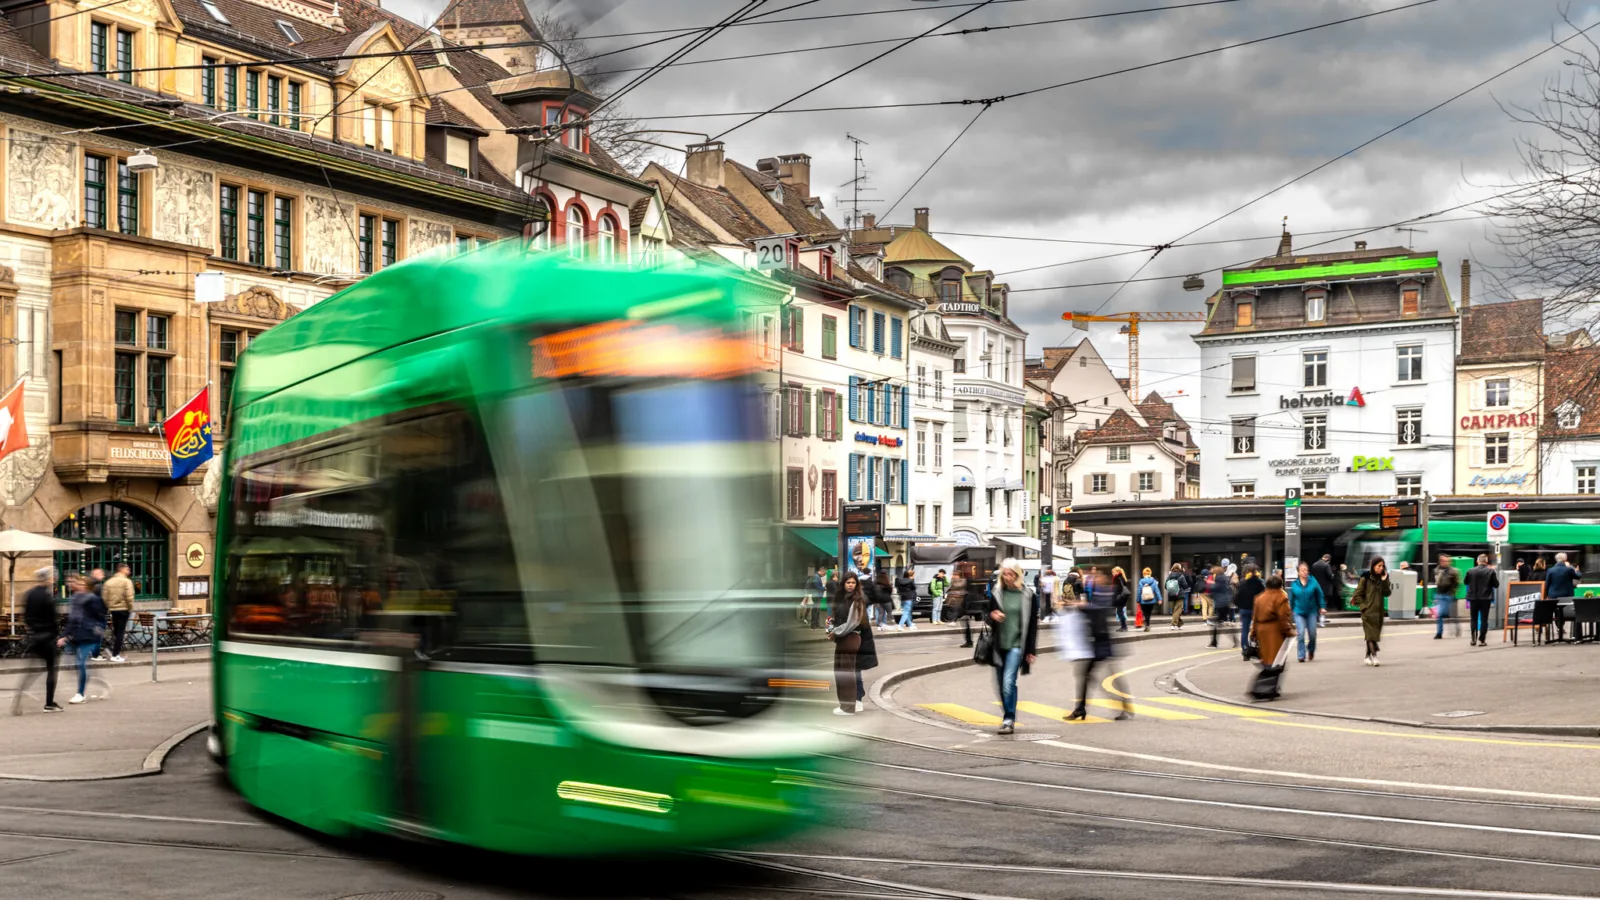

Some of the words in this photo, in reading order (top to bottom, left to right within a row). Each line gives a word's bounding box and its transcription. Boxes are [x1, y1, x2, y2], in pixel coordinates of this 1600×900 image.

[760, 244, 783, 264] 20
[943, 303, 980, 312] TADTHOF
[1280, 392, 1344, 408] helvetia
[1460, 413, 1537, 430] CAMPARI
[1268, 458, 1306, 467] VORSORGE
[1308, 457, 1322, 465] AUF
[1275, 468, 1299, 476] PUNKT
[1301, 466, 1340, 475] GEBRACHT
[1288, 489, 1296, 498] D
[1043, 506, 1049, 515] C
